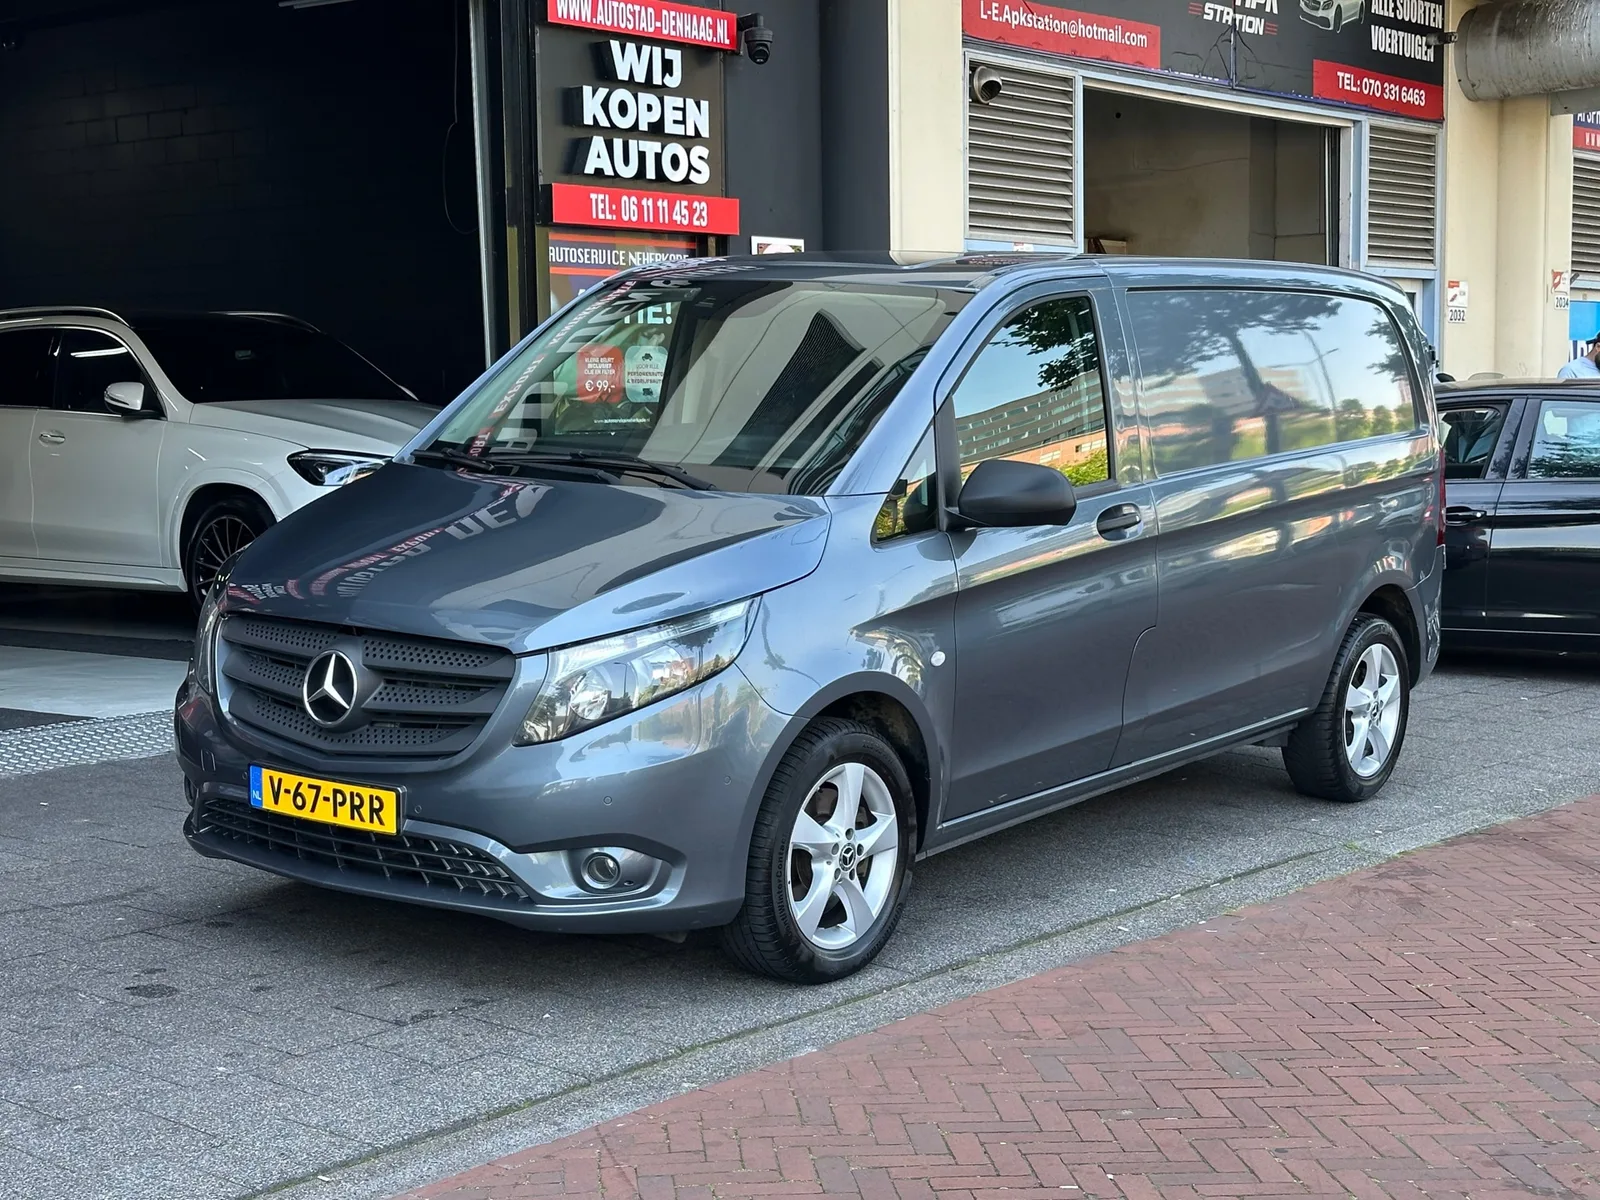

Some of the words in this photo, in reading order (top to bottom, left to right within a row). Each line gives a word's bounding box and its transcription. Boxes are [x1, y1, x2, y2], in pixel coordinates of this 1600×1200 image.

[556, 0, 730, 45] WWW.AUTOSTAD-DENHAAG.NL
[980, 0, 1148, 48] L-E.Apkstation@hotmail.com
[1203, 2, 1265, 36] STATION
[1371, 0, 1395, 18] ALLE
[1396, 0, 1443, 29] SOORTEN
[610, 39, 682, 89] WIJ
[1337, 71, 1361, 93] TEL:
[1362, 77, 1381, 98] 070
[1383, 82, 1399, 102] 331
[1401, 86, 1426, 107] 6463
[582, 84, 710, 138] KOPEN
[583, 135, 711, 185] AUTOS
[590, 192, 617, 221] TEL:
[621, 195, 638, 222] 06
[641, 197, 654, 223] 11
[657, 198, 669, 224] 11
[672, 200, 689, 226] 45
[692, 201, 708, 227] 23
[1449, 309, 1466, 322] 2032
[1555, 296, 1569, 308] 2034
[253, 790, 262, 801] NL
[269, 775, 386, 826] V-67-PRR
